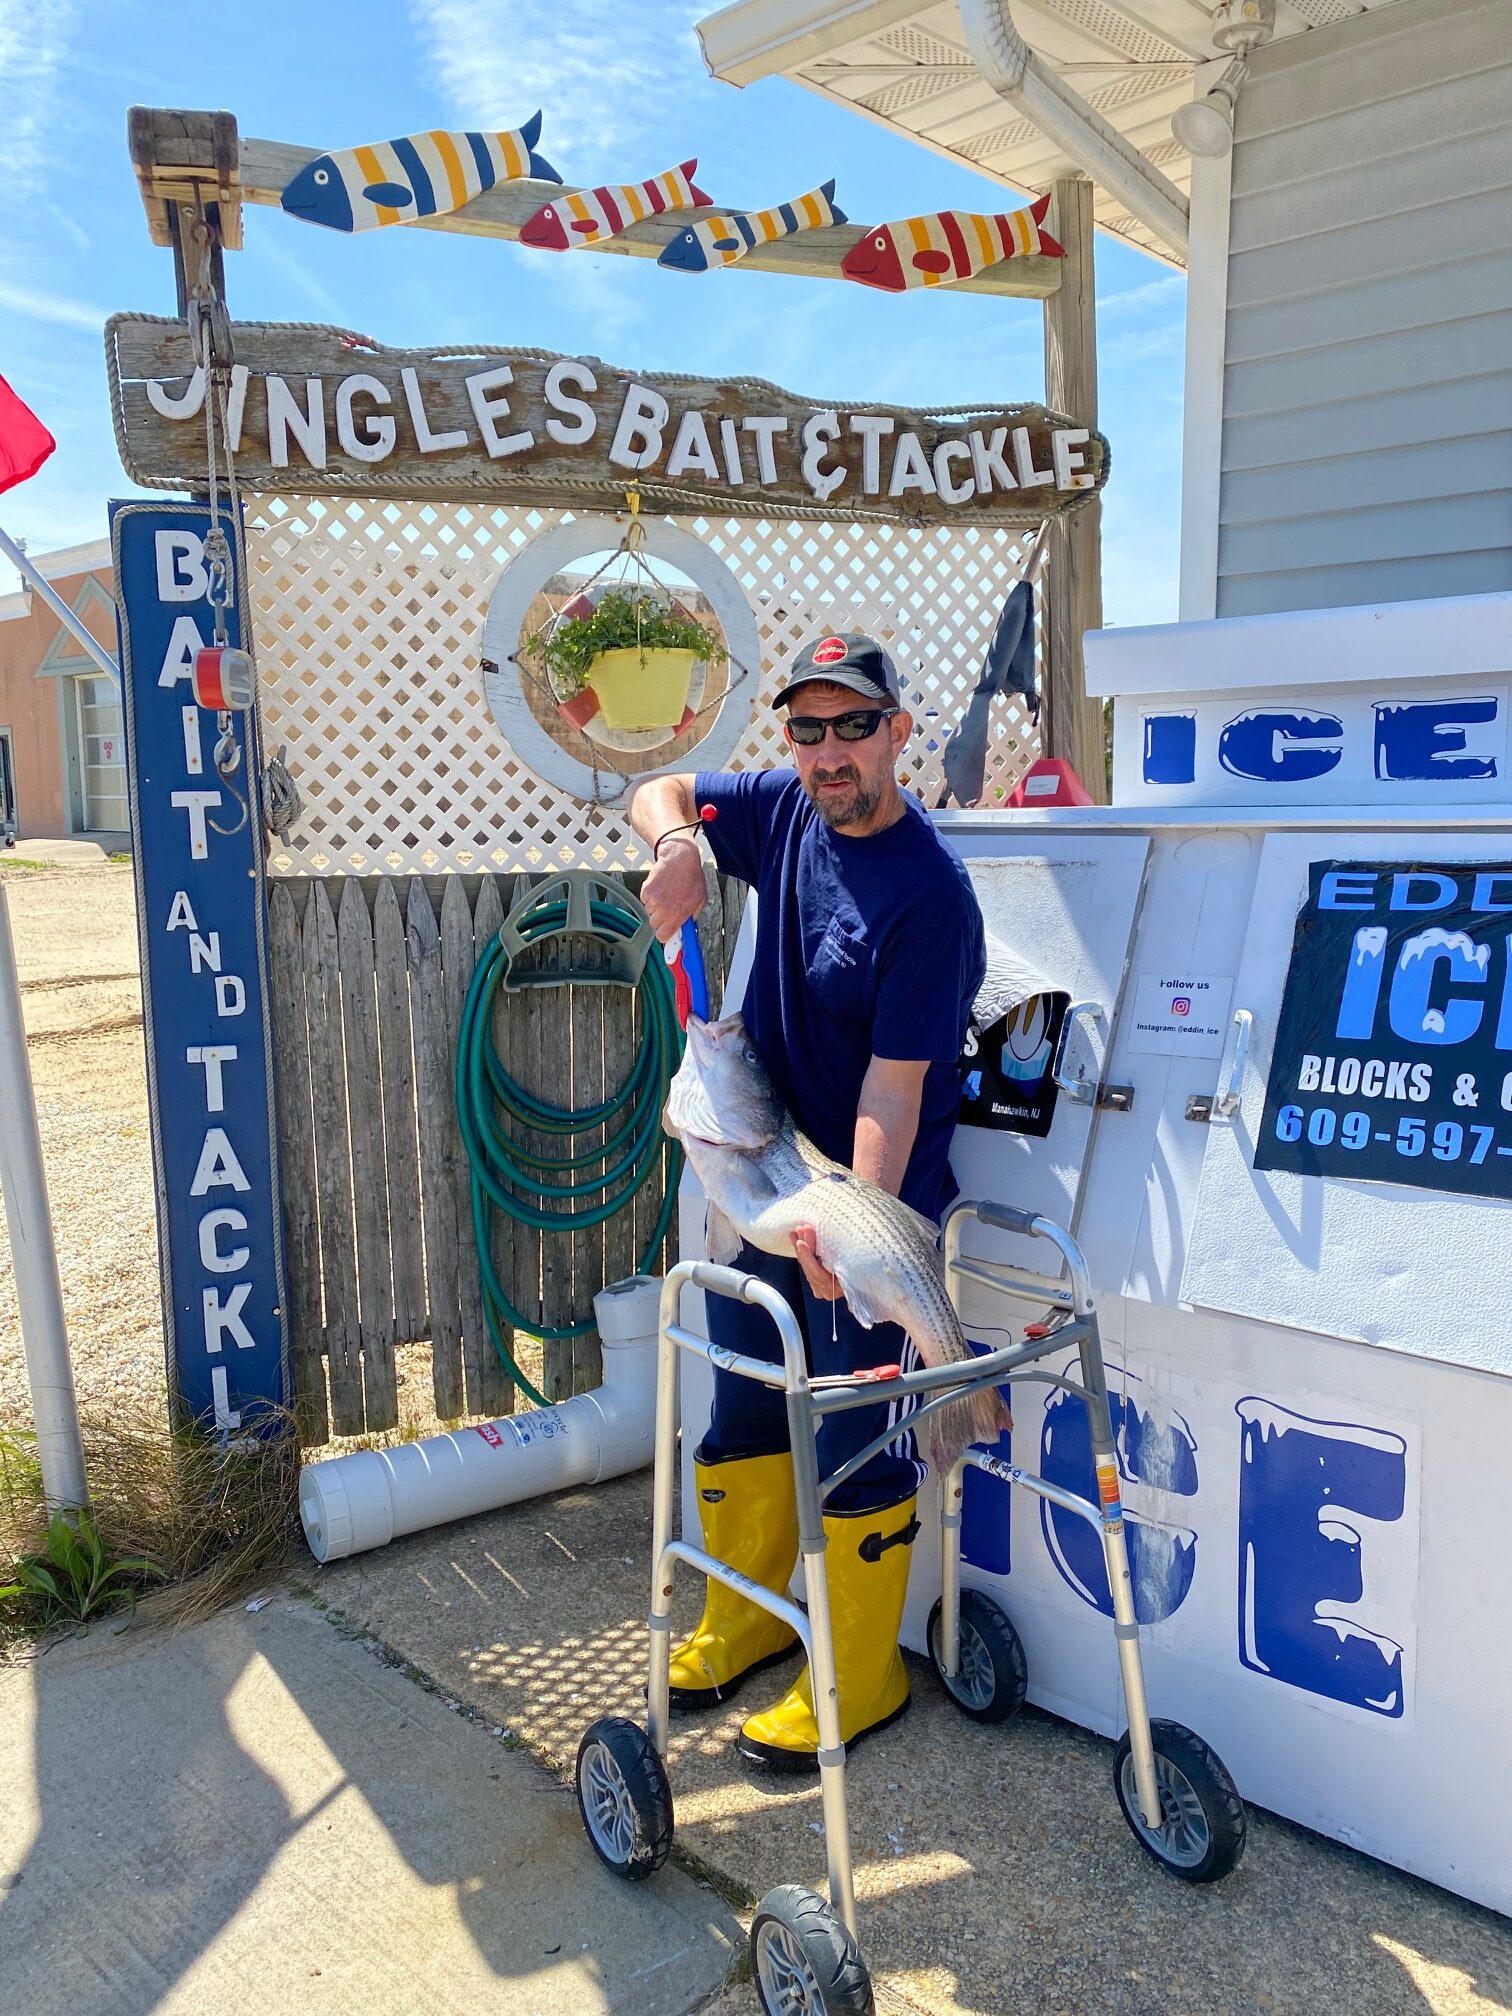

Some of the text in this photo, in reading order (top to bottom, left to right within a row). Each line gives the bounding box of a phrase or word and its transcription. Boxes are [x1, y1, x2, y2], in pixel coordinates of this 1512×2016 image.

[145, 361, 1095, 504] JINGLES BAIT & TACKLE
[155, 530, 222, 860] BAIT
[1141, 697, 1498, 784] ICE
[166, 891, 246, 1016] AND
[1160, 979, 1210, 990] Follow us
[1336, 926, 1512, 1050] IC
[1137, 1023, 1176, 1033] Instagram:
[1031, 1108, 1041, 1119] NJ
[1298, 1055, 1432, 1102] BLOCKS
[1452, 1073, 1479, 1107] &
[950, 1322, 1408, 1718] ICE
